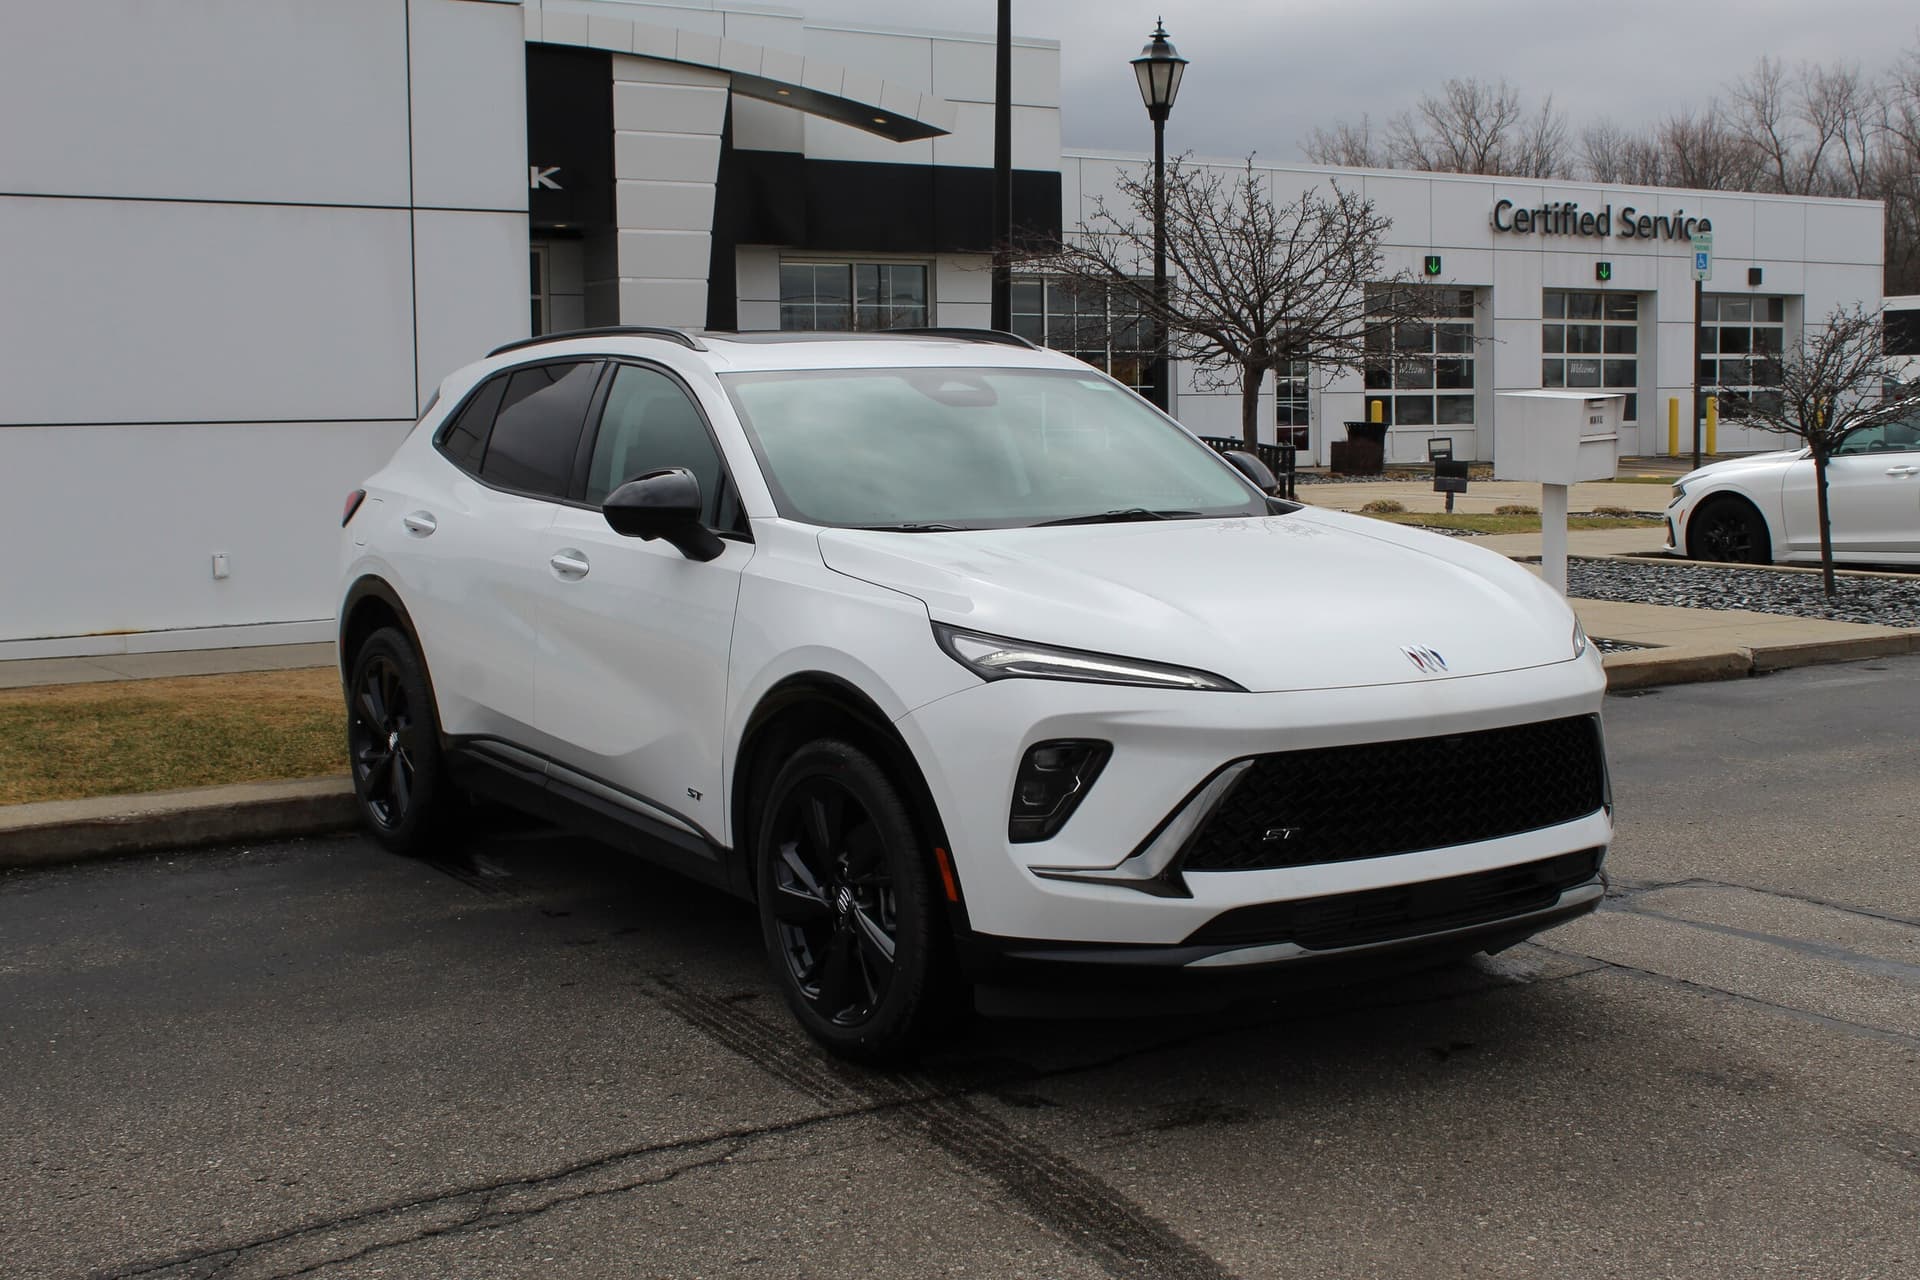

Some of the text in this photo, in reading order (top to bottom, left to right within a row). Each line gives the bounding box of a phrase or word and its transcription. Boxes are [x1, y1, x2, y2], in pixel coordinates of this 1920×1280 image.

[530, 166, 563, 189] K
[1493, 199, 1712, 241] Certified Service
[687, 787, 704, 802] ST
[1262, 827, 1300, 841] ST
